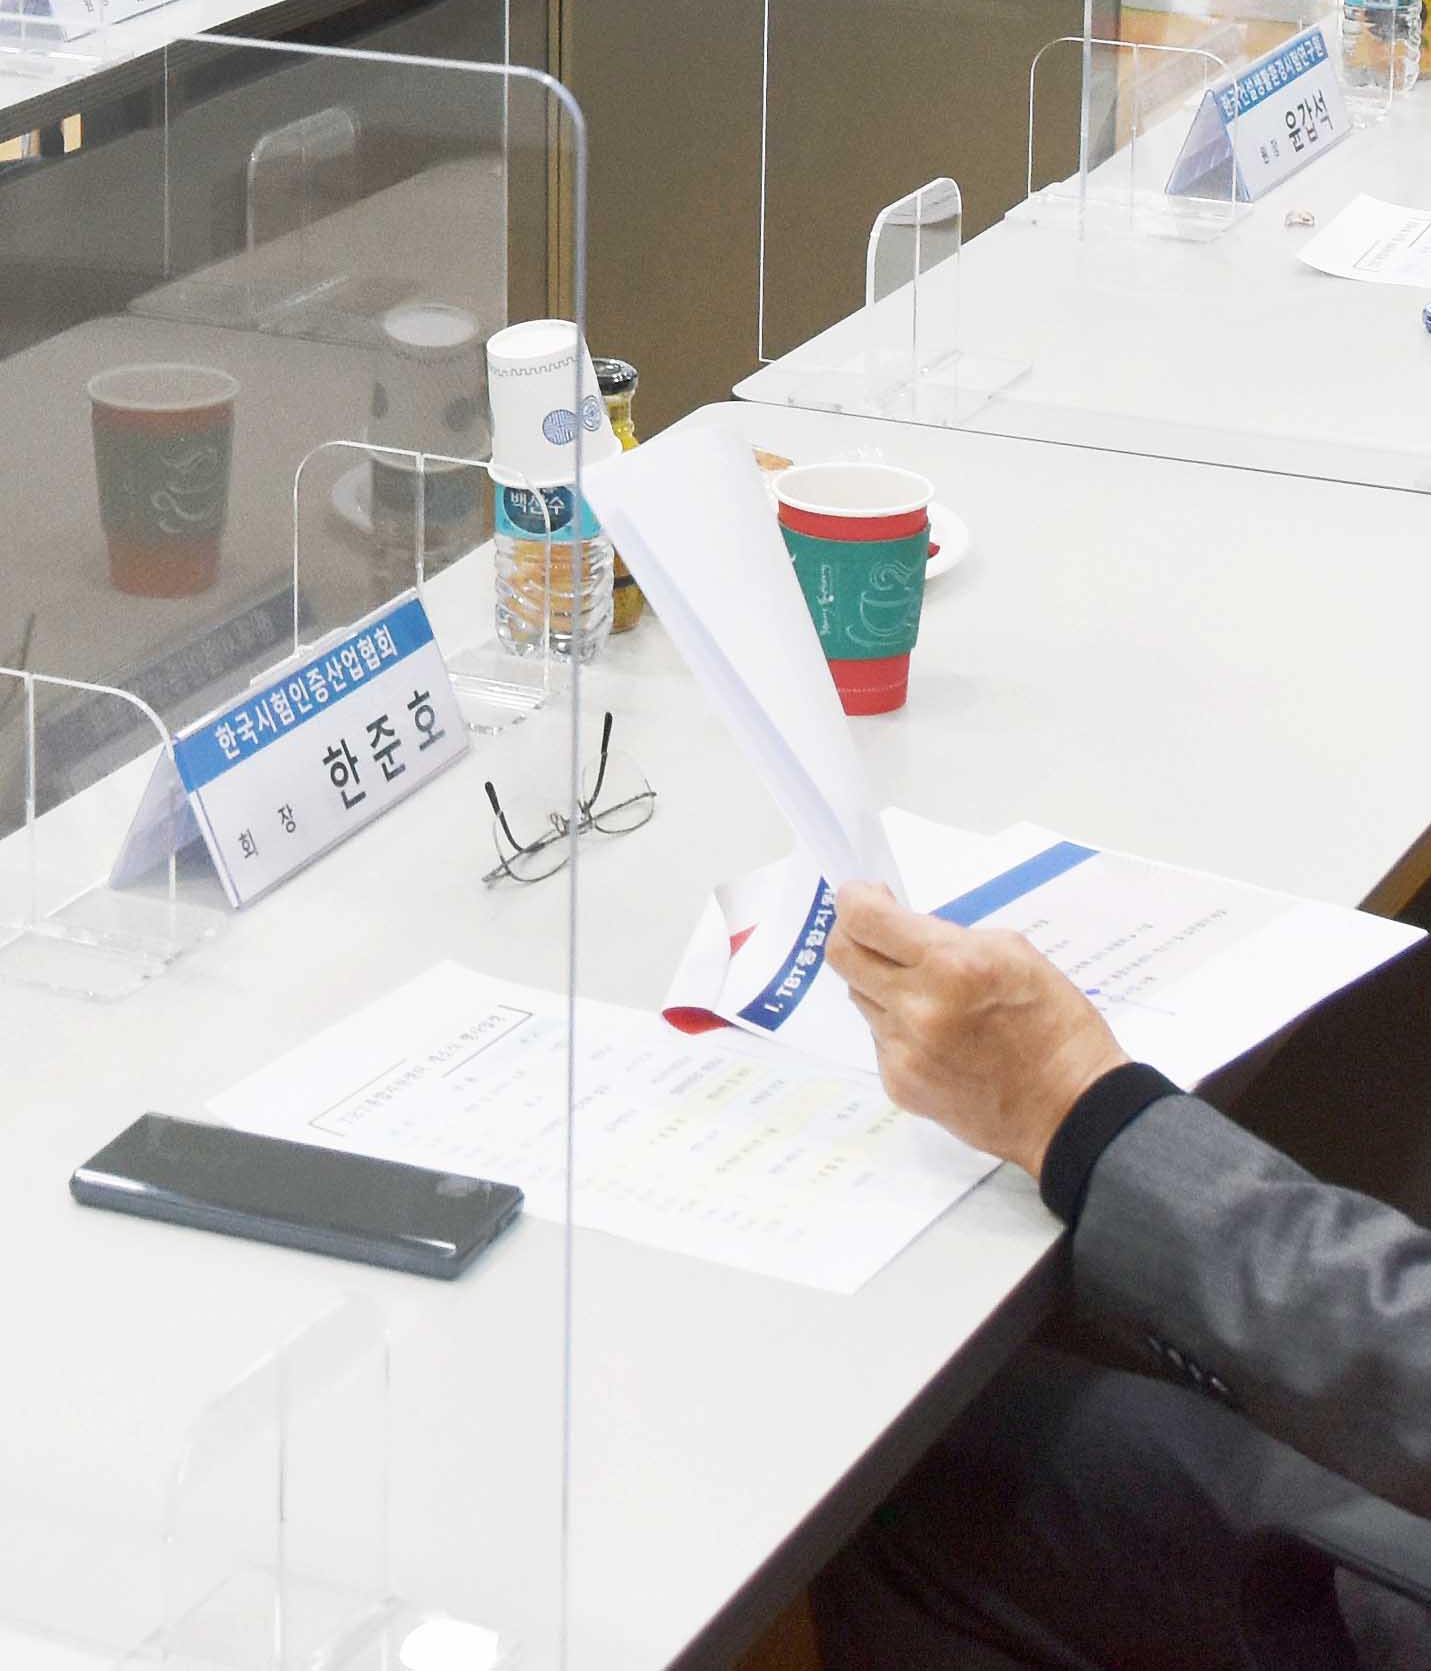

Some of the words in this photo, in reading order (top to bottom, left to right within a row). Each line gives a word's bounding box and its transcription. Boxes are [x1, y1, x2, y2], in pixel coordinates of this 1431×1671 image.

[1285, 88, 1334, 153] 윤갑석
[213, 623, 399, 761] 한국시험인증산업협회
[321, 688, 448, 811] 한준호
